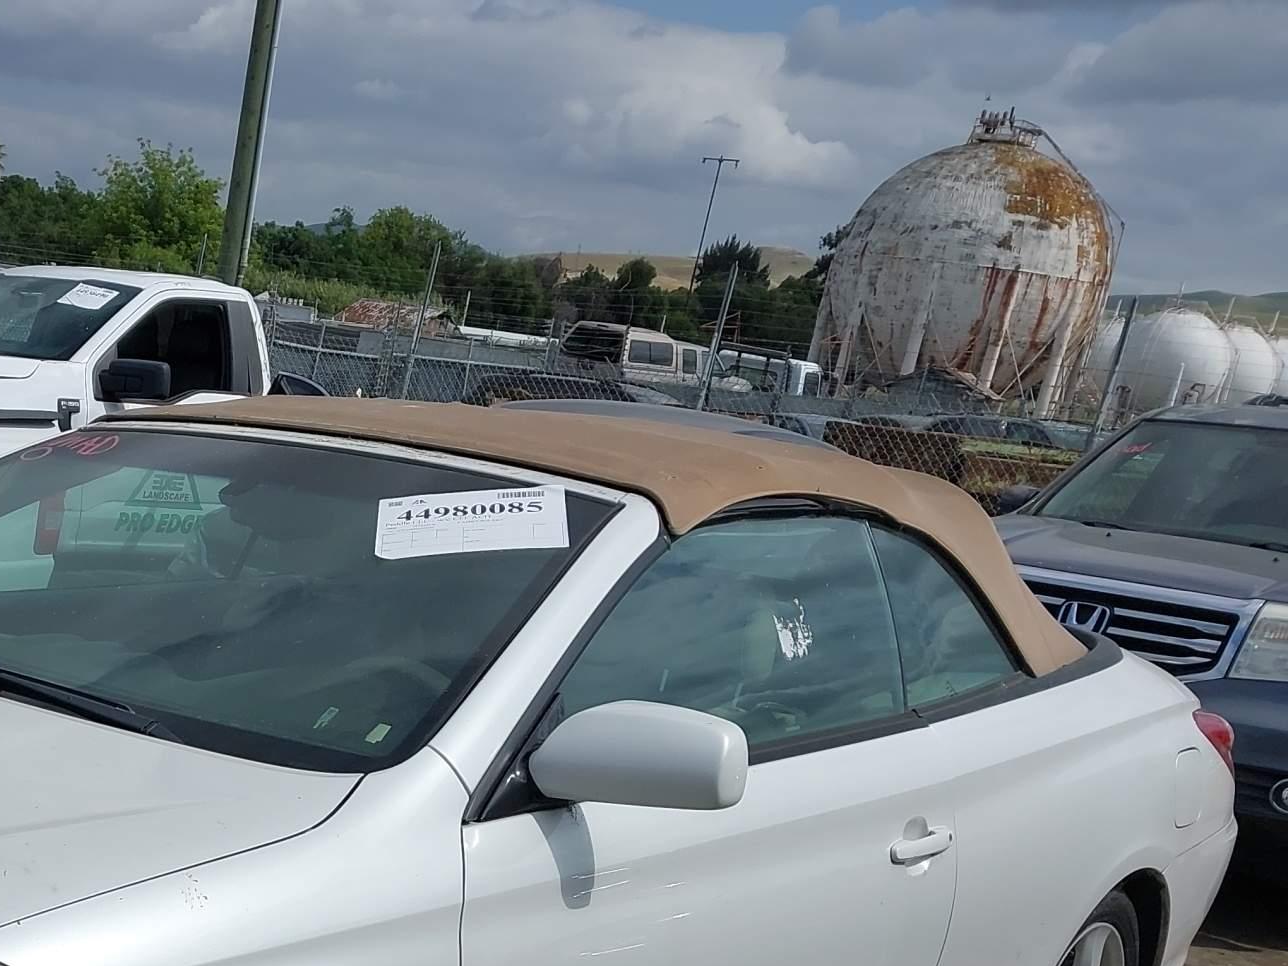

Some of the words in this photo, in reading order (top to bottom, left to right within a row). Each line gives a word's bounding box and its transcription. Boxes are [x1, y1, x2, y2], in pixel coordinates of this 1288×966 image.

[142, 490, 190, 502] LANDSCAPE
[396, 501, 544, 521] 44980085
[114, 511, 155, 532] PRO
